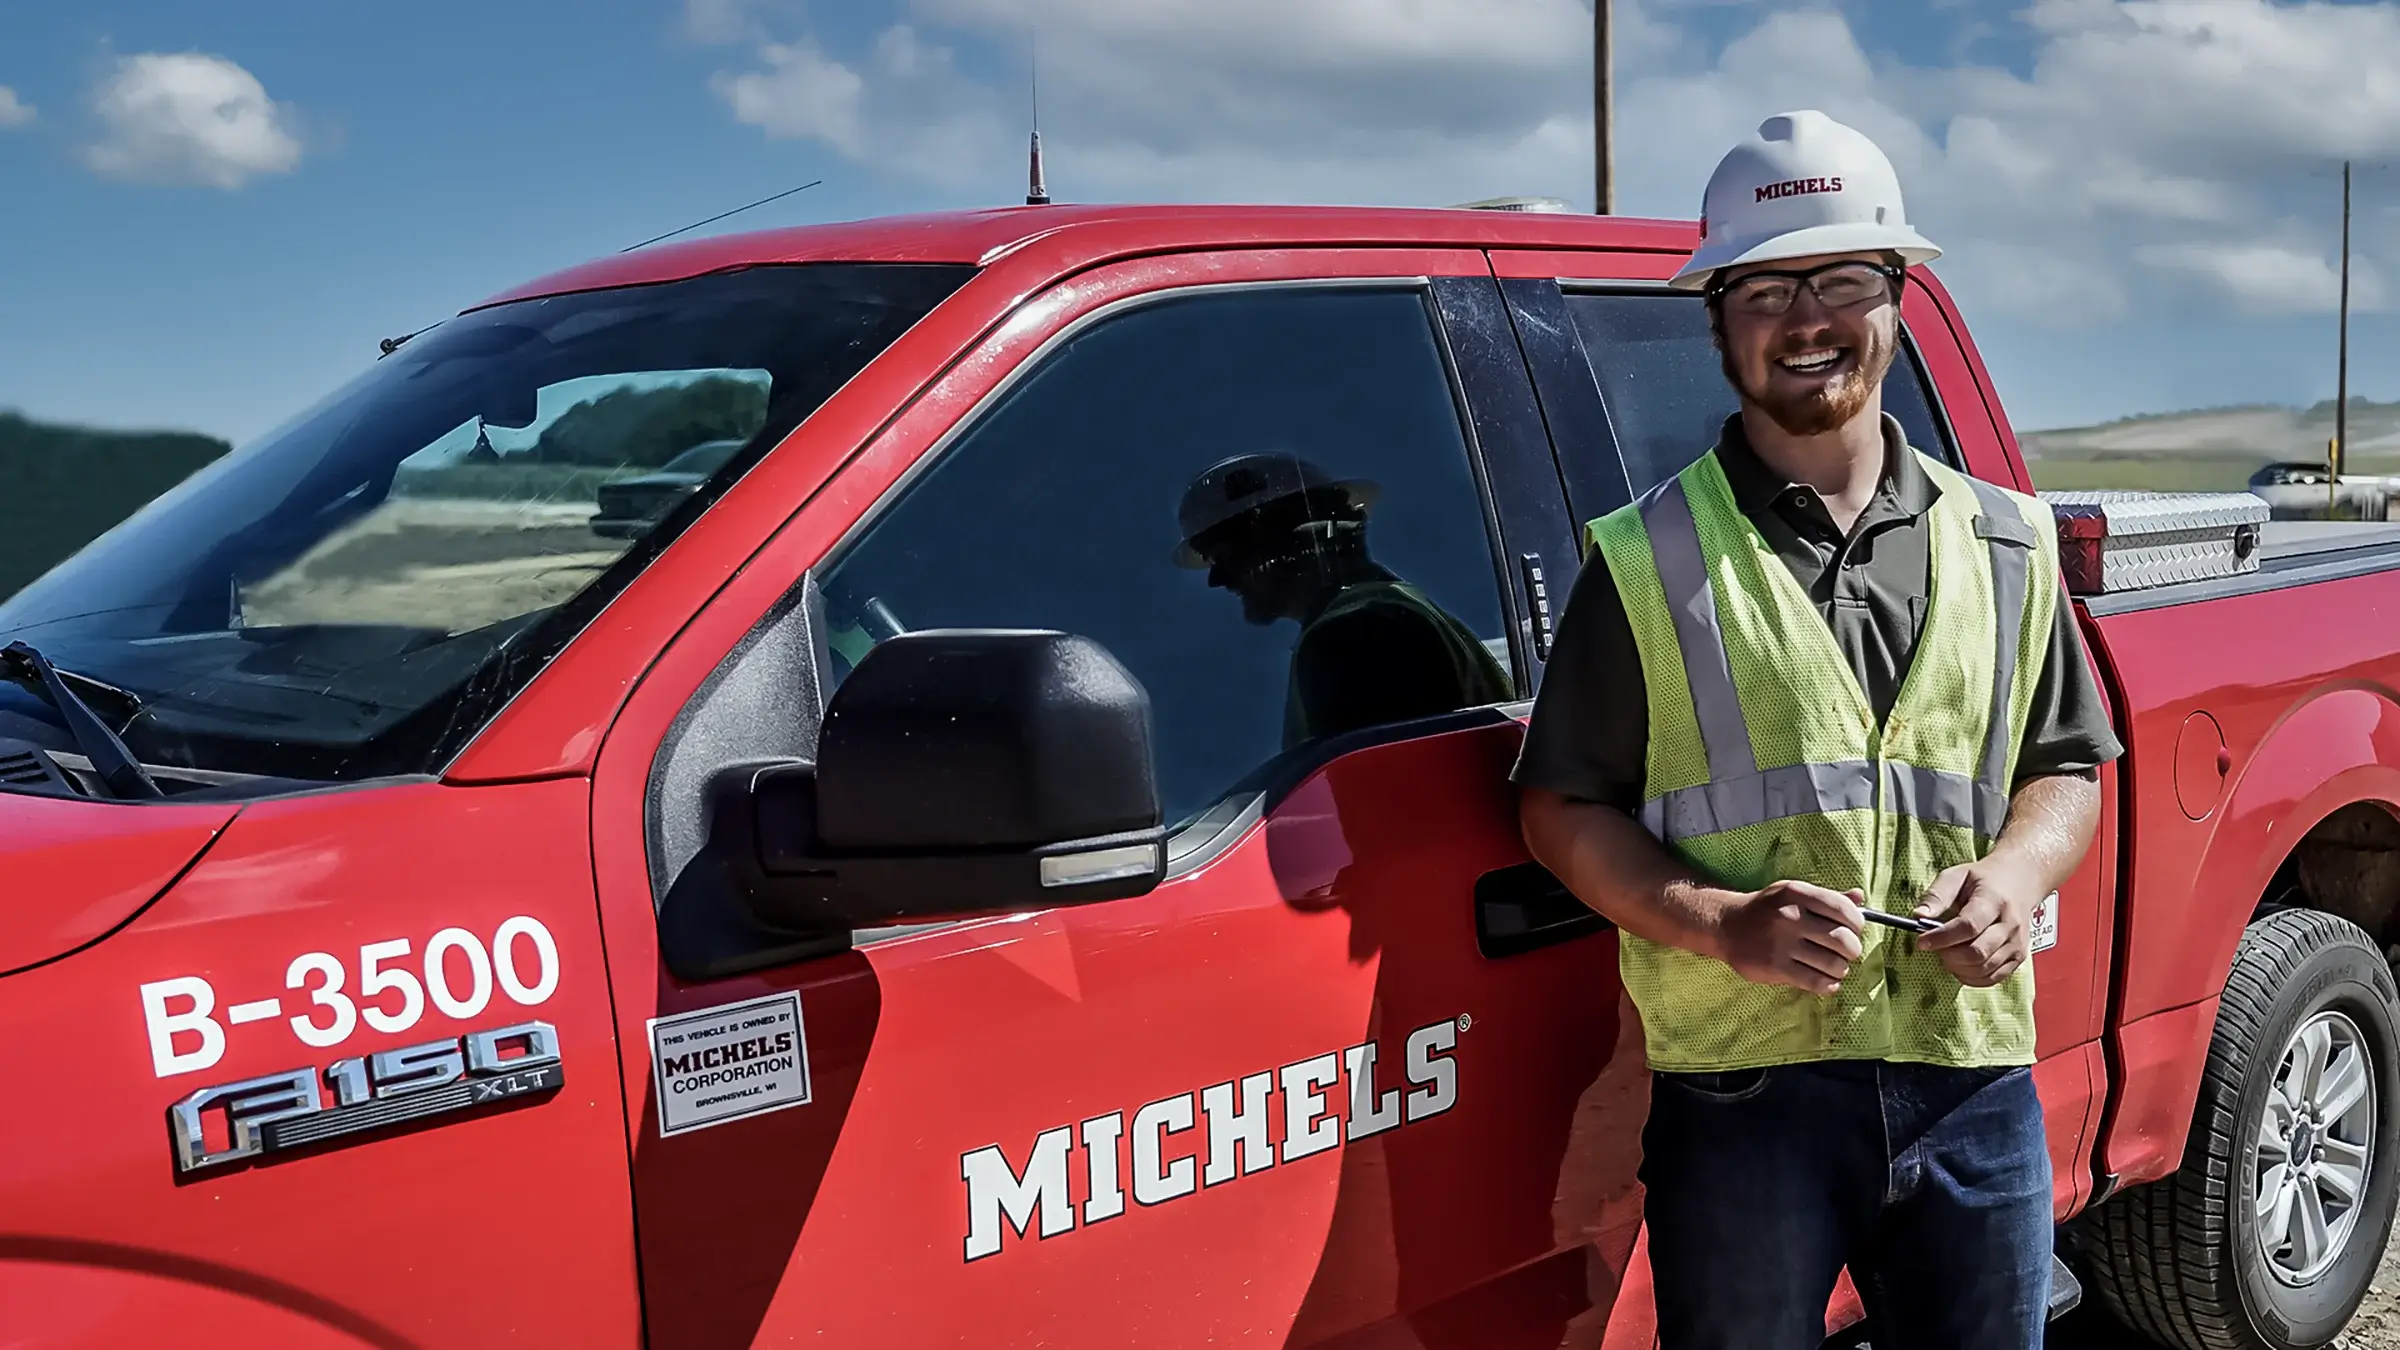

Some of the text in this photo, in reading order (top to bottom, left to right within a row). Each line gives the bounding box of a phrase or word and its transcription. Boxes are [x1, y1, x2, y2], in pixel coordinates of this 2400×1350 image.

[1755, 177, 1843, 202] MICHELS
[2042, 924, 2053, 935] AID
[140, 915, 560, 1078] B-3500
[662, 1012, 791, 1046] THIS VEHICLE IS OWNED BY
[663, 1032, 792, 1078] MICHELS
[476, 1069, 549, 1100] XLT
[673, 1056, 793, 1094] CORPORATION
[765, 1082, 777, 1092] WI
